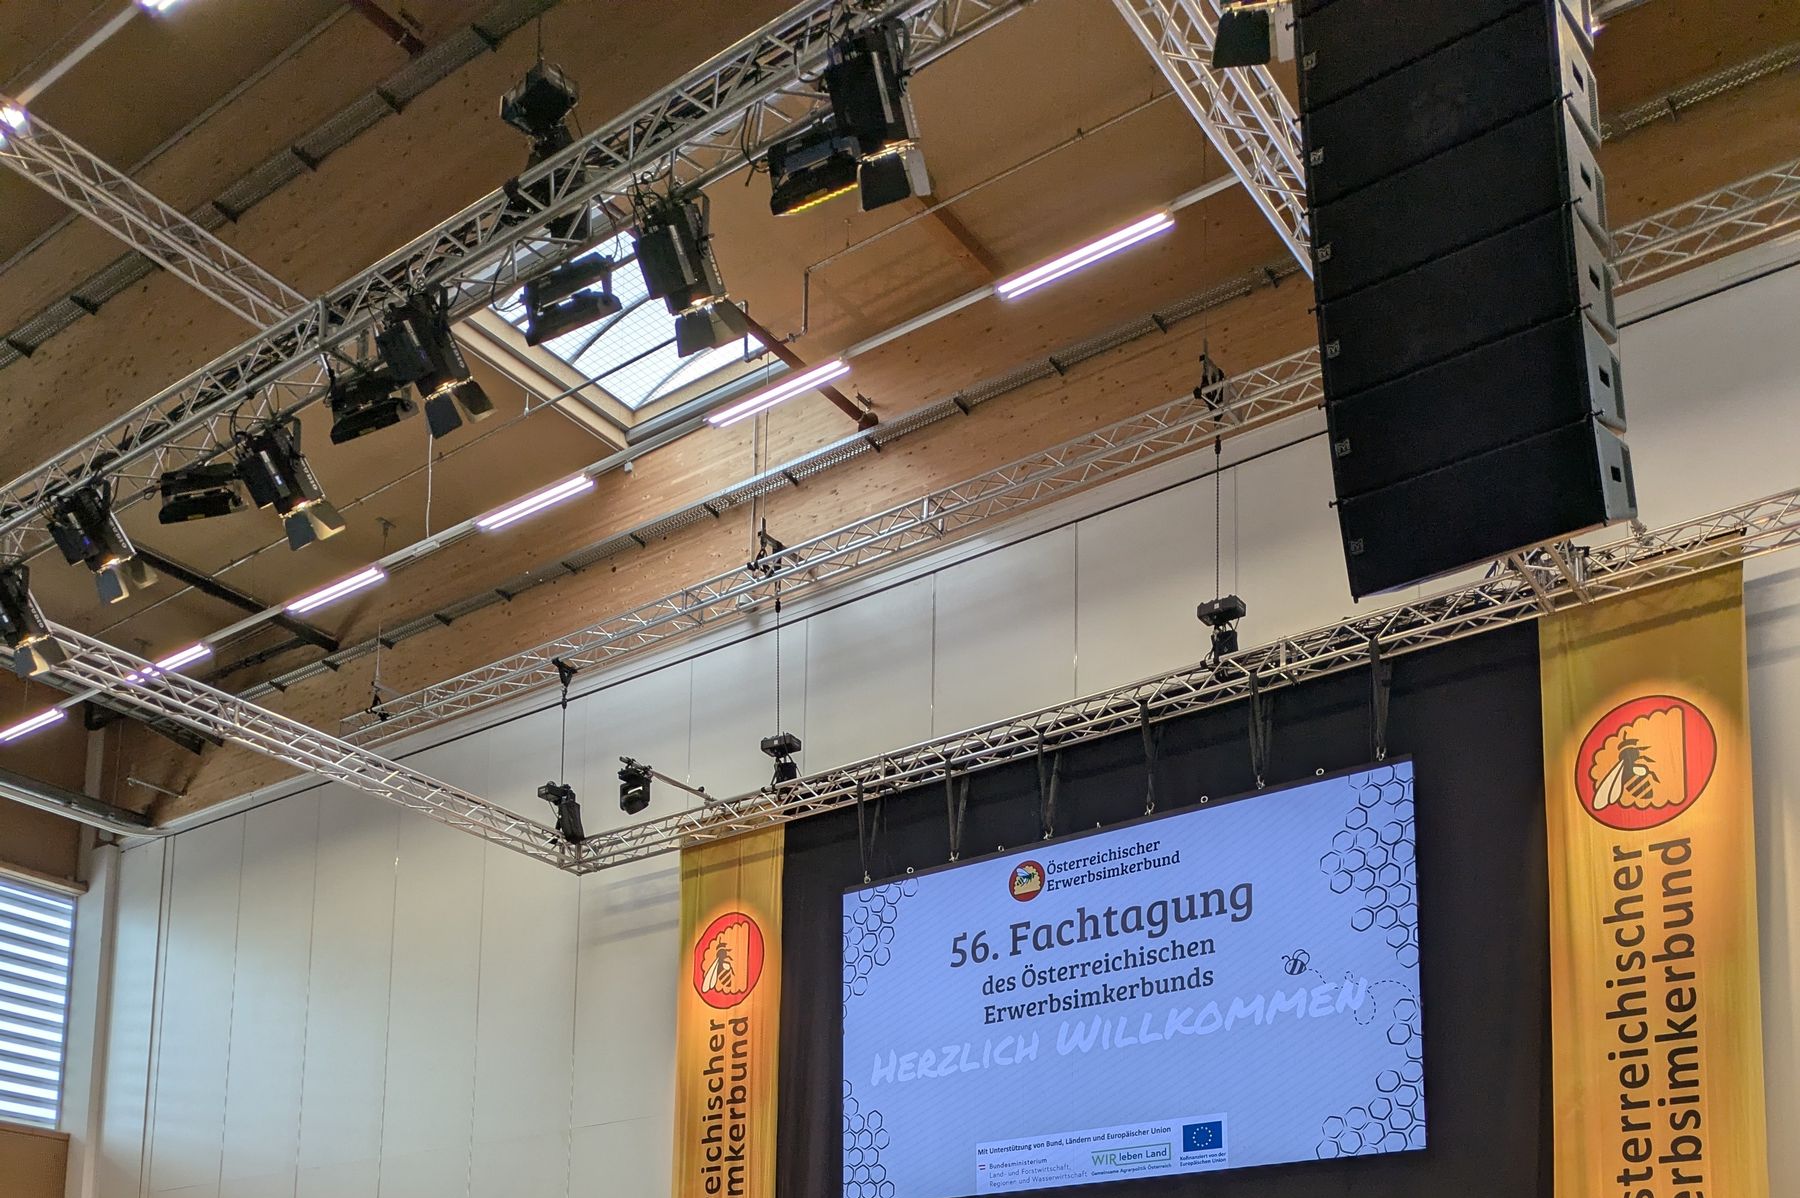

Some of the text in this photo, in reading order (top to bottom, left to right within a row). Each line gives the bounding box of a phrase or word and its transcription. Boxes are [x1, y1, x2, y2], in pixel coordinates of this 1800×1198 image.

[1047, 840, 1161, 875] Österreichischer
[1047, 850, 1181, 892] Erwerbsimkerbund
[949, 882, 1253, 968] 56. Fachtagung
[981, 936, 1216, 996] des Österreichischen
[983, 966, 1215, 1025] Erwerbsimkerbunds
[870, 976, 1370, 1087] HERZLICH WILLKOMMEN
[989, 1143, 1032, 1154] Unterstützung
[1046, 1139, 1064, 1148] Bund,
[1066, 1135, 1091, 1145] Ländern
[1093, 1134, 1105, 1142] und
[1107, 1128, 1149, 1140] Europäischer
[1151, 1126, 1171, 1134] Union
[1091, 1148, 1167, 1166] WIR leben Land
[989, 1158, 1048, 1169] Bundesministerium
[1008, 1169, 1019, 1177] und
